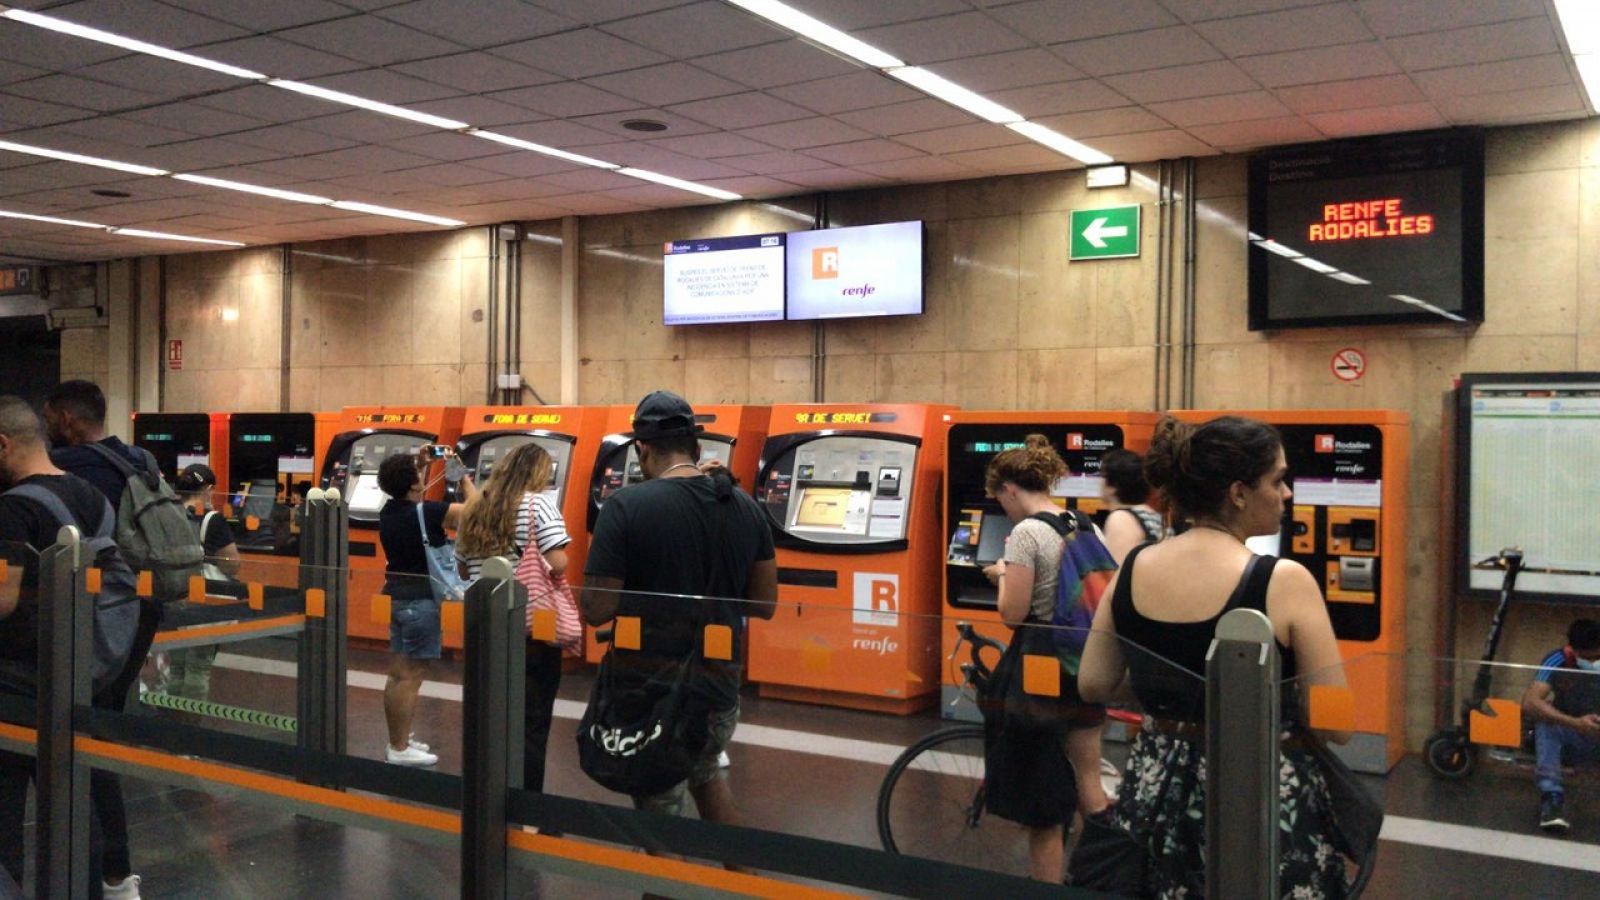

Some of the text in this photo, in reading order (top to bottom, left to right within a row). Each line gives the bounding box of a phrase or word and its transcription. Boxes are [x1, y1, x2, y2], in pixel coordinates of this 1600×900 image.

[1324, 199, 1401, 221] RENFE
[1309, 216, 1433, 241] RODALIES
[842, 283, 875, 298] renfe
[492, 414, 513, 424] FORA
[516, 414, 528, 424] DE
[813, 413, 827, 423] DE
[831, 413, 871, 423] SERVEI
[1084, 439, 1114, 447] Rodalies
[1335, 441, 1371, 449] Rodalies
[1084, 460, 1103, 470] renf
[1335, 464, 1364, 475] renfe
[871, 580, 896, 611] R
[852, 636, 898, 656] renfe
